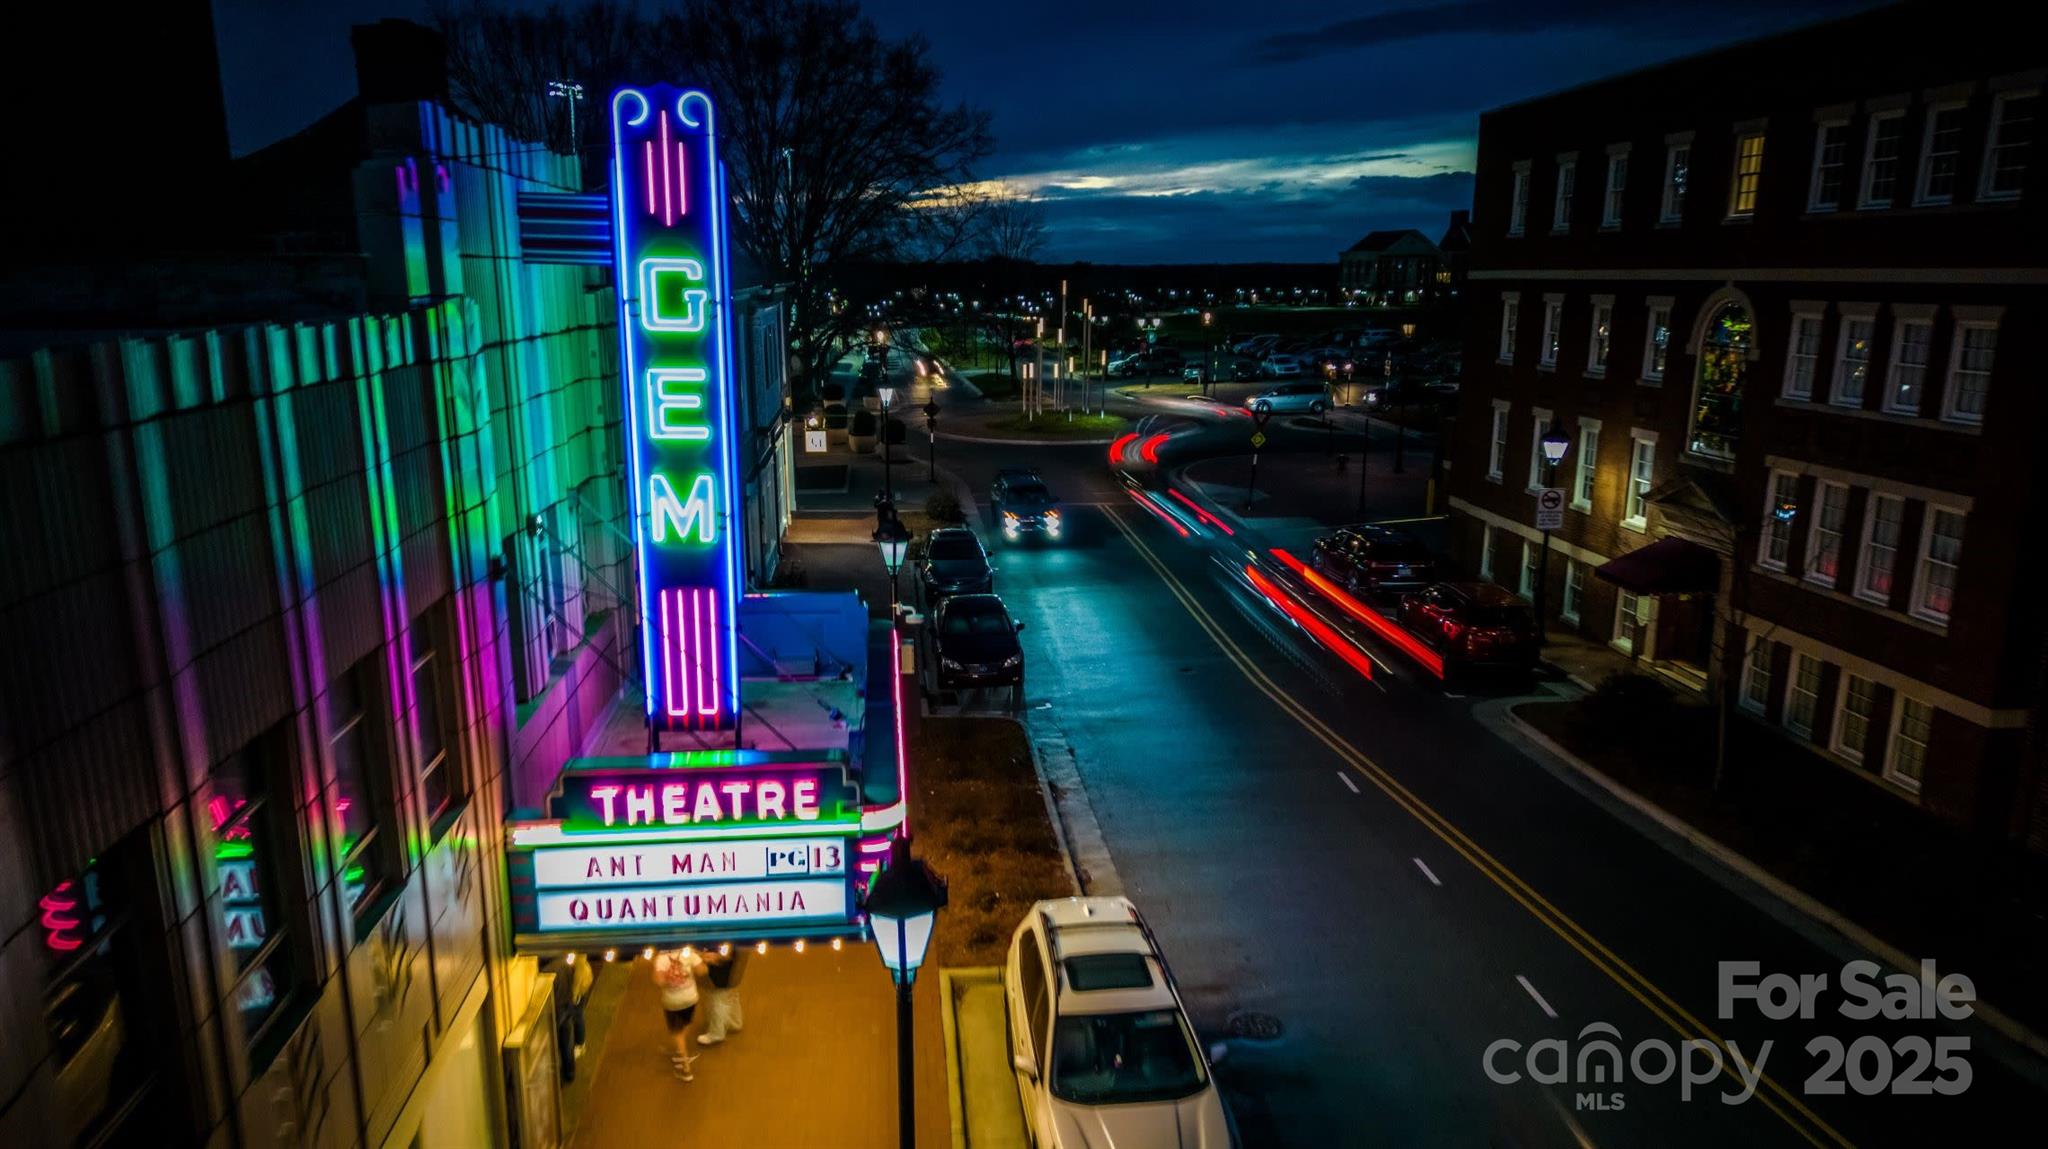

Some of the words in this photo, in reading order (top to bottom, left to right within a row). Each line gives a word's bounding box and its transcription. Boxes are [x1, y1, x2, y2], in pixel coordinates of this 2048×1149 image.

[638, 258, 715, 543] GEM
[592, 780, 820, 826] THEATRE
[586, 855, 643, 878] ANT
[672, 851, 737, 875] MAN
[570, 890, 806, 920] QUANTUMANIA
